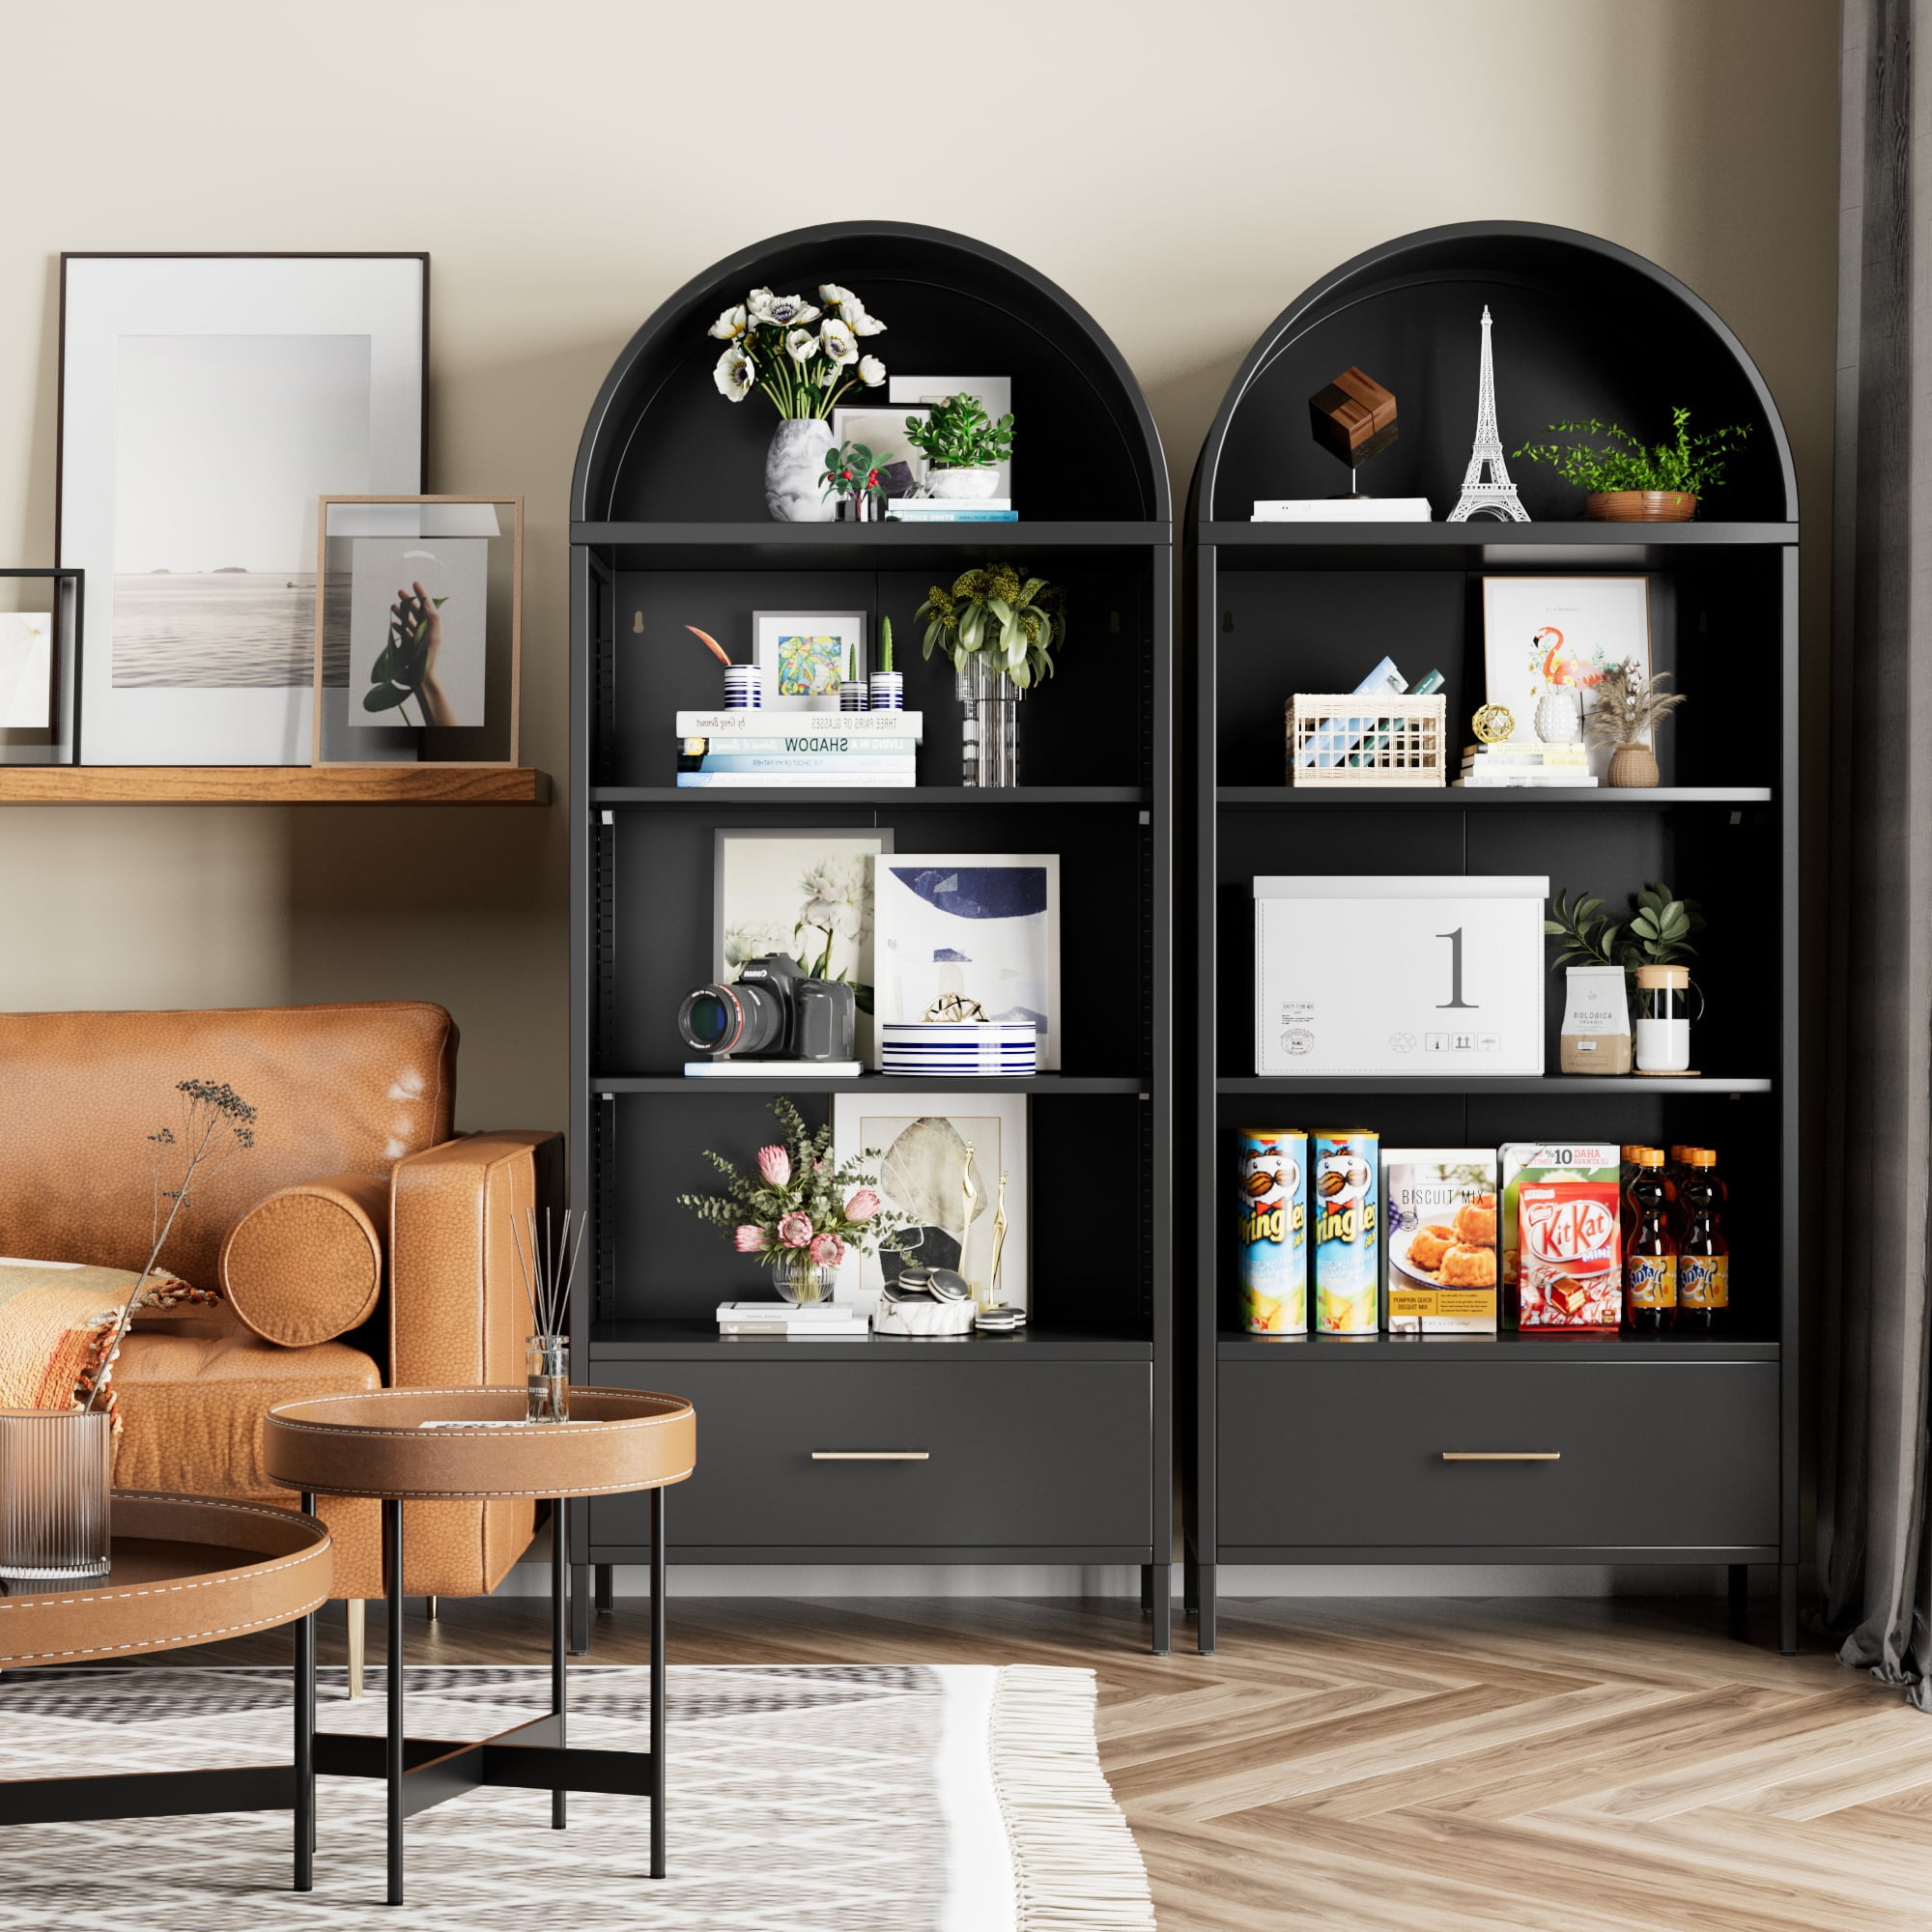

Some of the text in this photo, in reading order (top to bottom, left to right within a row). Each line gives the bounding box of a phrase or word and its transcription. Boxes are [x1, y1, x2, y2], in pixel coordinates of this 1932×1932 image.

[1435, 926, 1480, 1009] 1
[1574, 1149, 1601, 1158] DAHA
[1402, 1189, 1484, 1205] BISCUIT MIX
